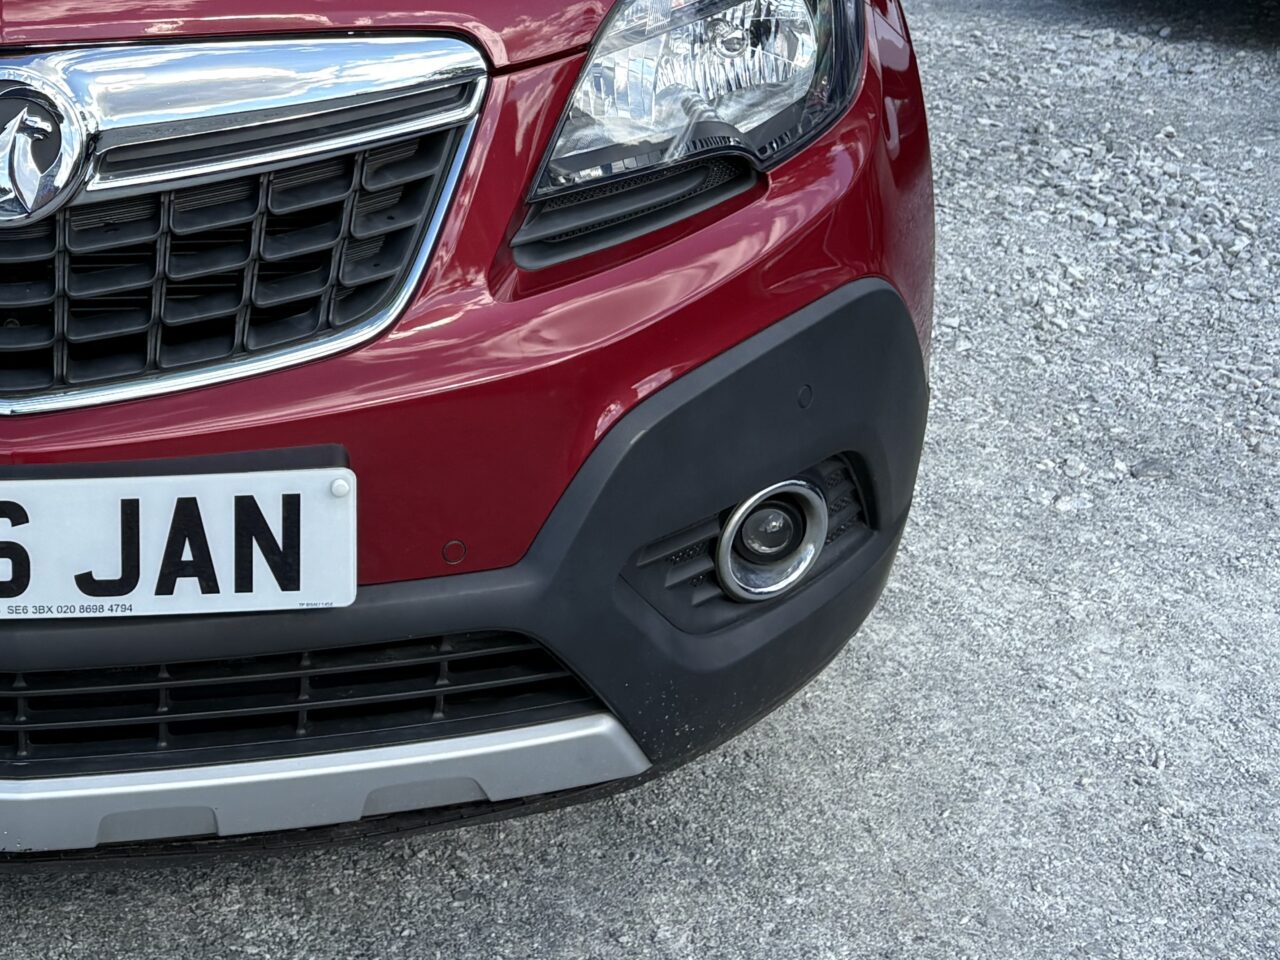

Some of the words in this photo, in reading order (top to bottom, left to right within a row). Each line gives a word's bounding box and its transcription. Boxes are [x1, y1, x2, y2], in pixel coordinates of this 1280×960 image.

[73, 493, 302, 598] JAN
[7, 604, 29, 615] SE6
[31, 604, 54, 615] 3BX
[56, 603, 76, 614] 020
[78, 603, 105, 614] 8698
[107, 603, 133, 614] 4794
